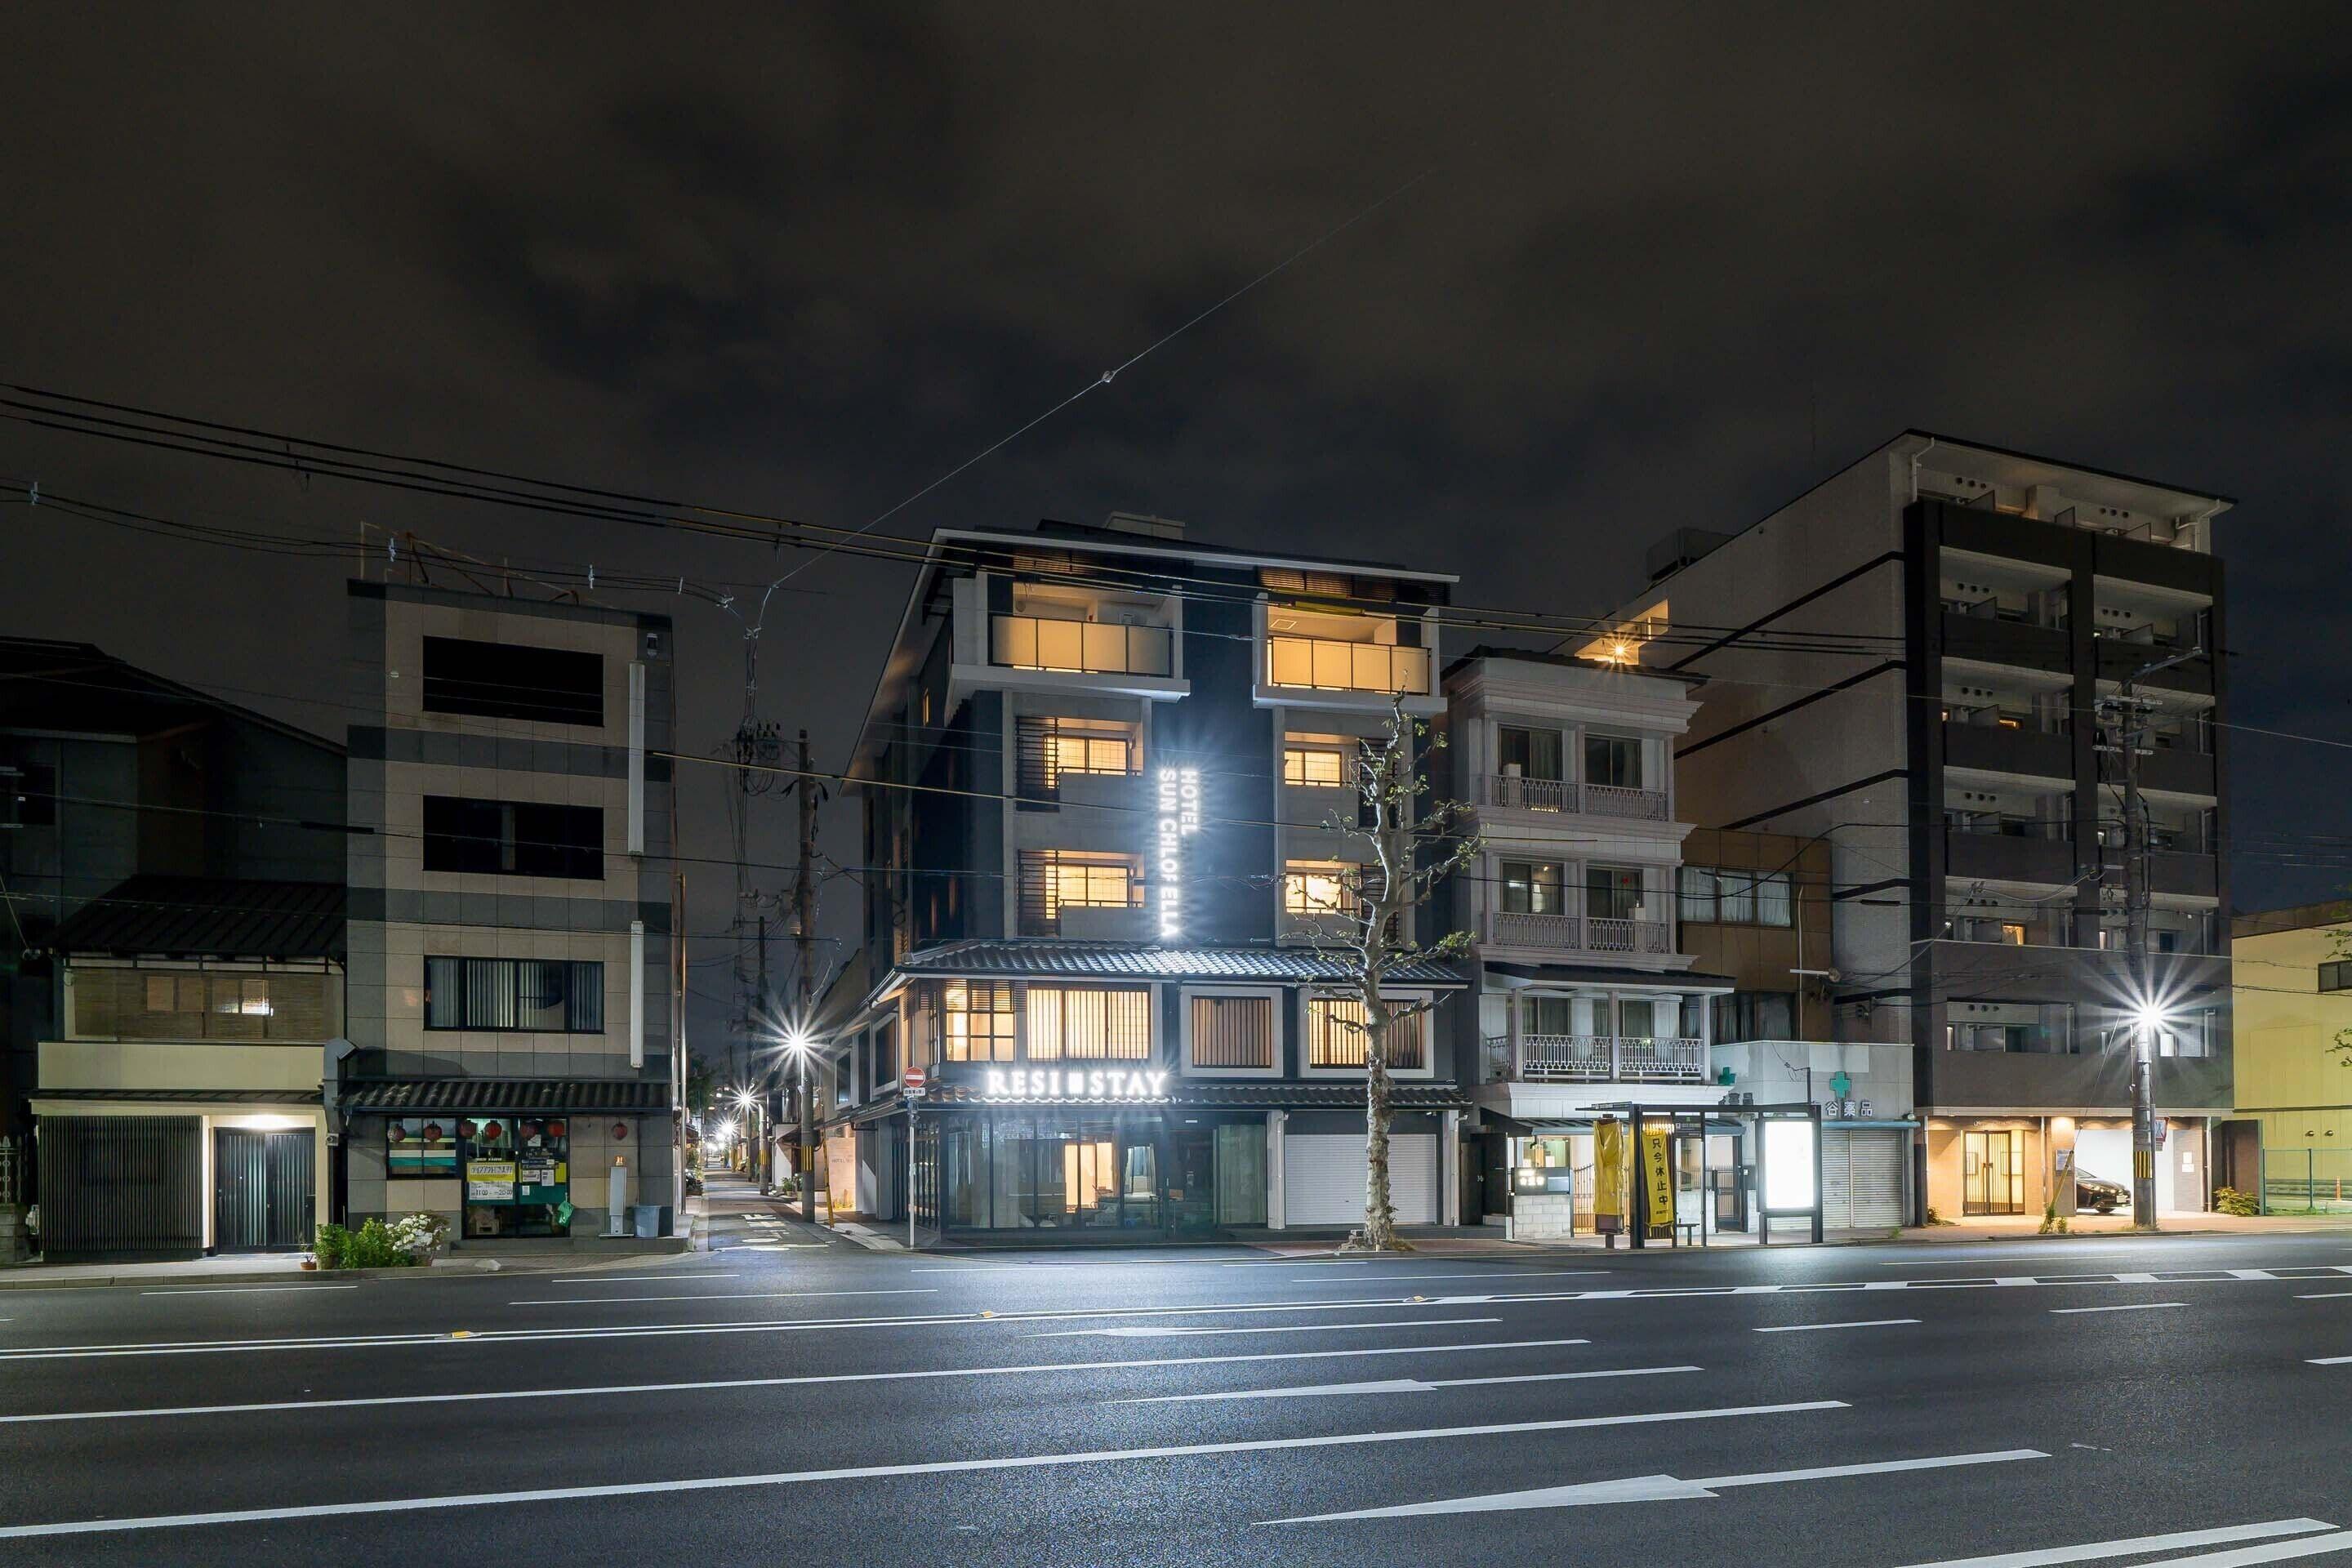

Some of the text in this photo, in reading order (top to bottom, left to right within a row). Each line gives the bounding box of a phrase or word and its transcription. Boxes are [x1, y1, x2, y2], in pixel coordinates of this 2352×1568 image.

[1160, 769, 1178, 811] SUN
[1181, 769, 1198, 836] HOTEL
[987, 1071, 1167, 1096] RESI STAY
[1825, 1100, 1873, 1117] 谷薬品
[1652, 1138, 1668, 1205] 只今休止中
